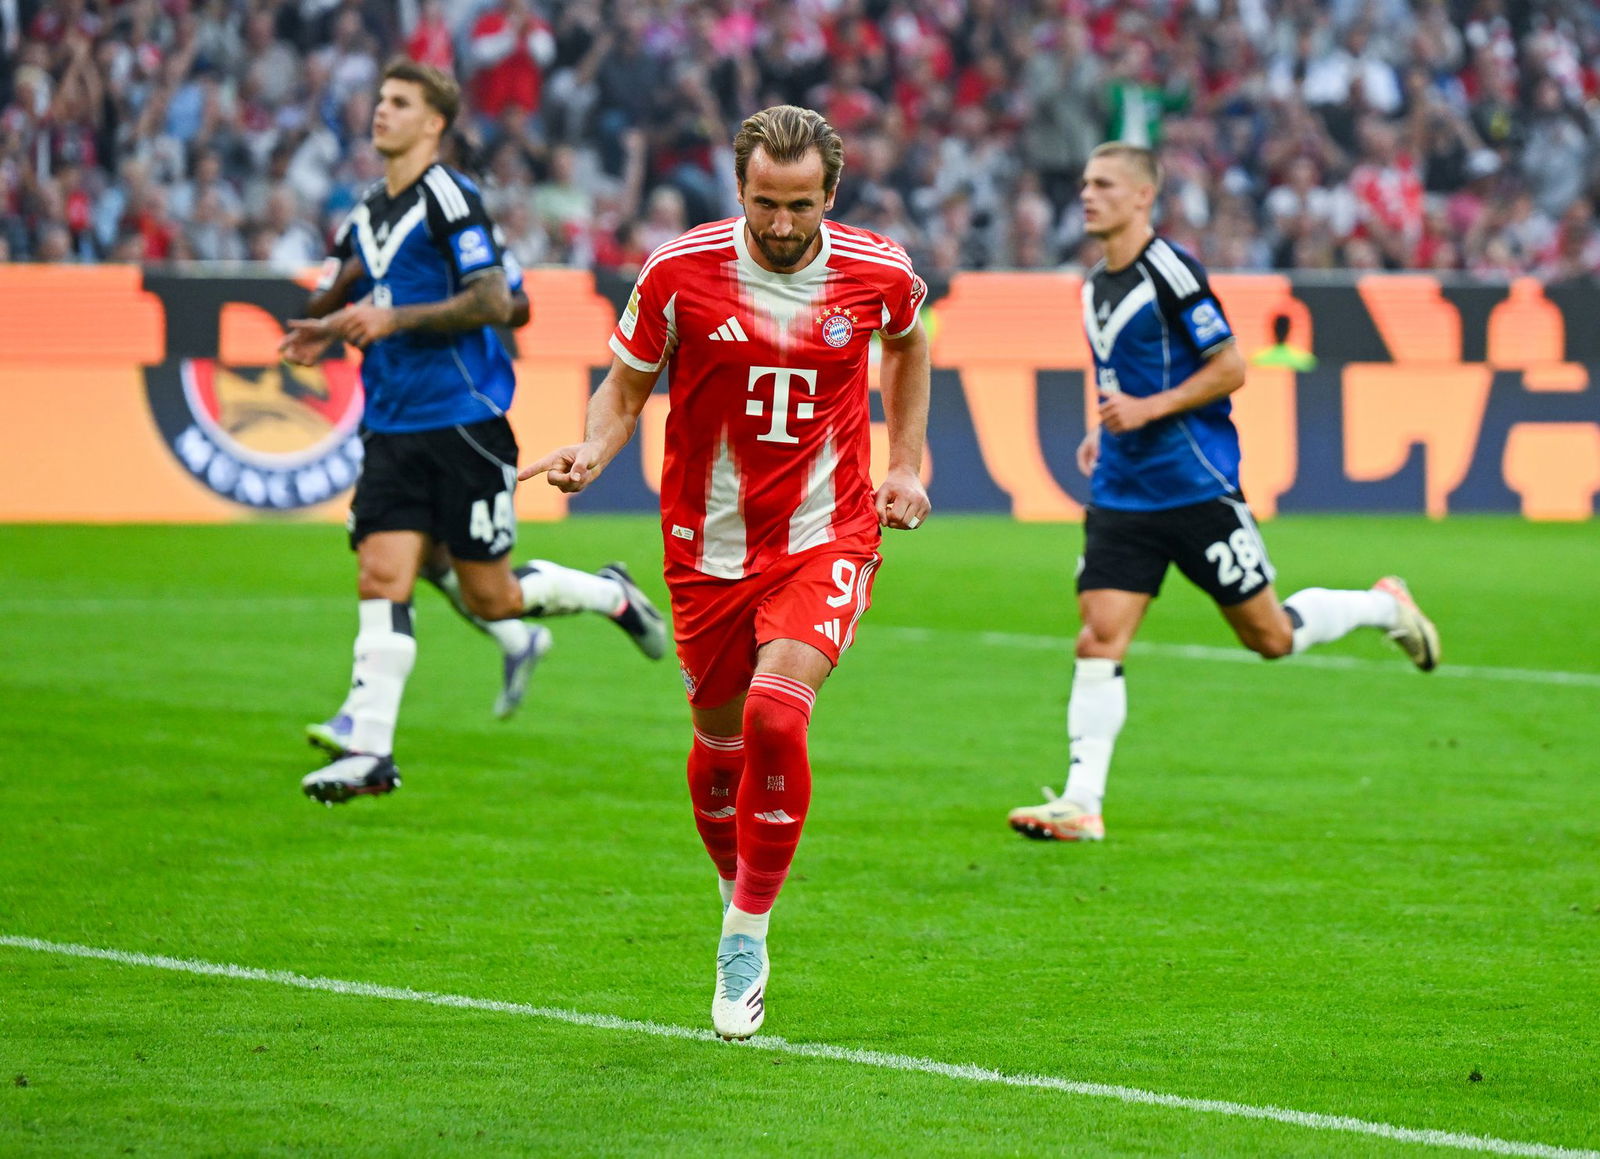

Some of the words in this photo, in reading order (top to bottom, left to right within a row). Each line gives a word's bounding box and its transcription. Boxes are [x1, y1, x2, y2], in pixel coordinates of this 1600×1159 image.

[831, 317, 851, 330] BAYERN
[469, 490, 514, 543] 44
[1205, 527, 1261, 586] 28
[826, 558, 857, 608] 9
